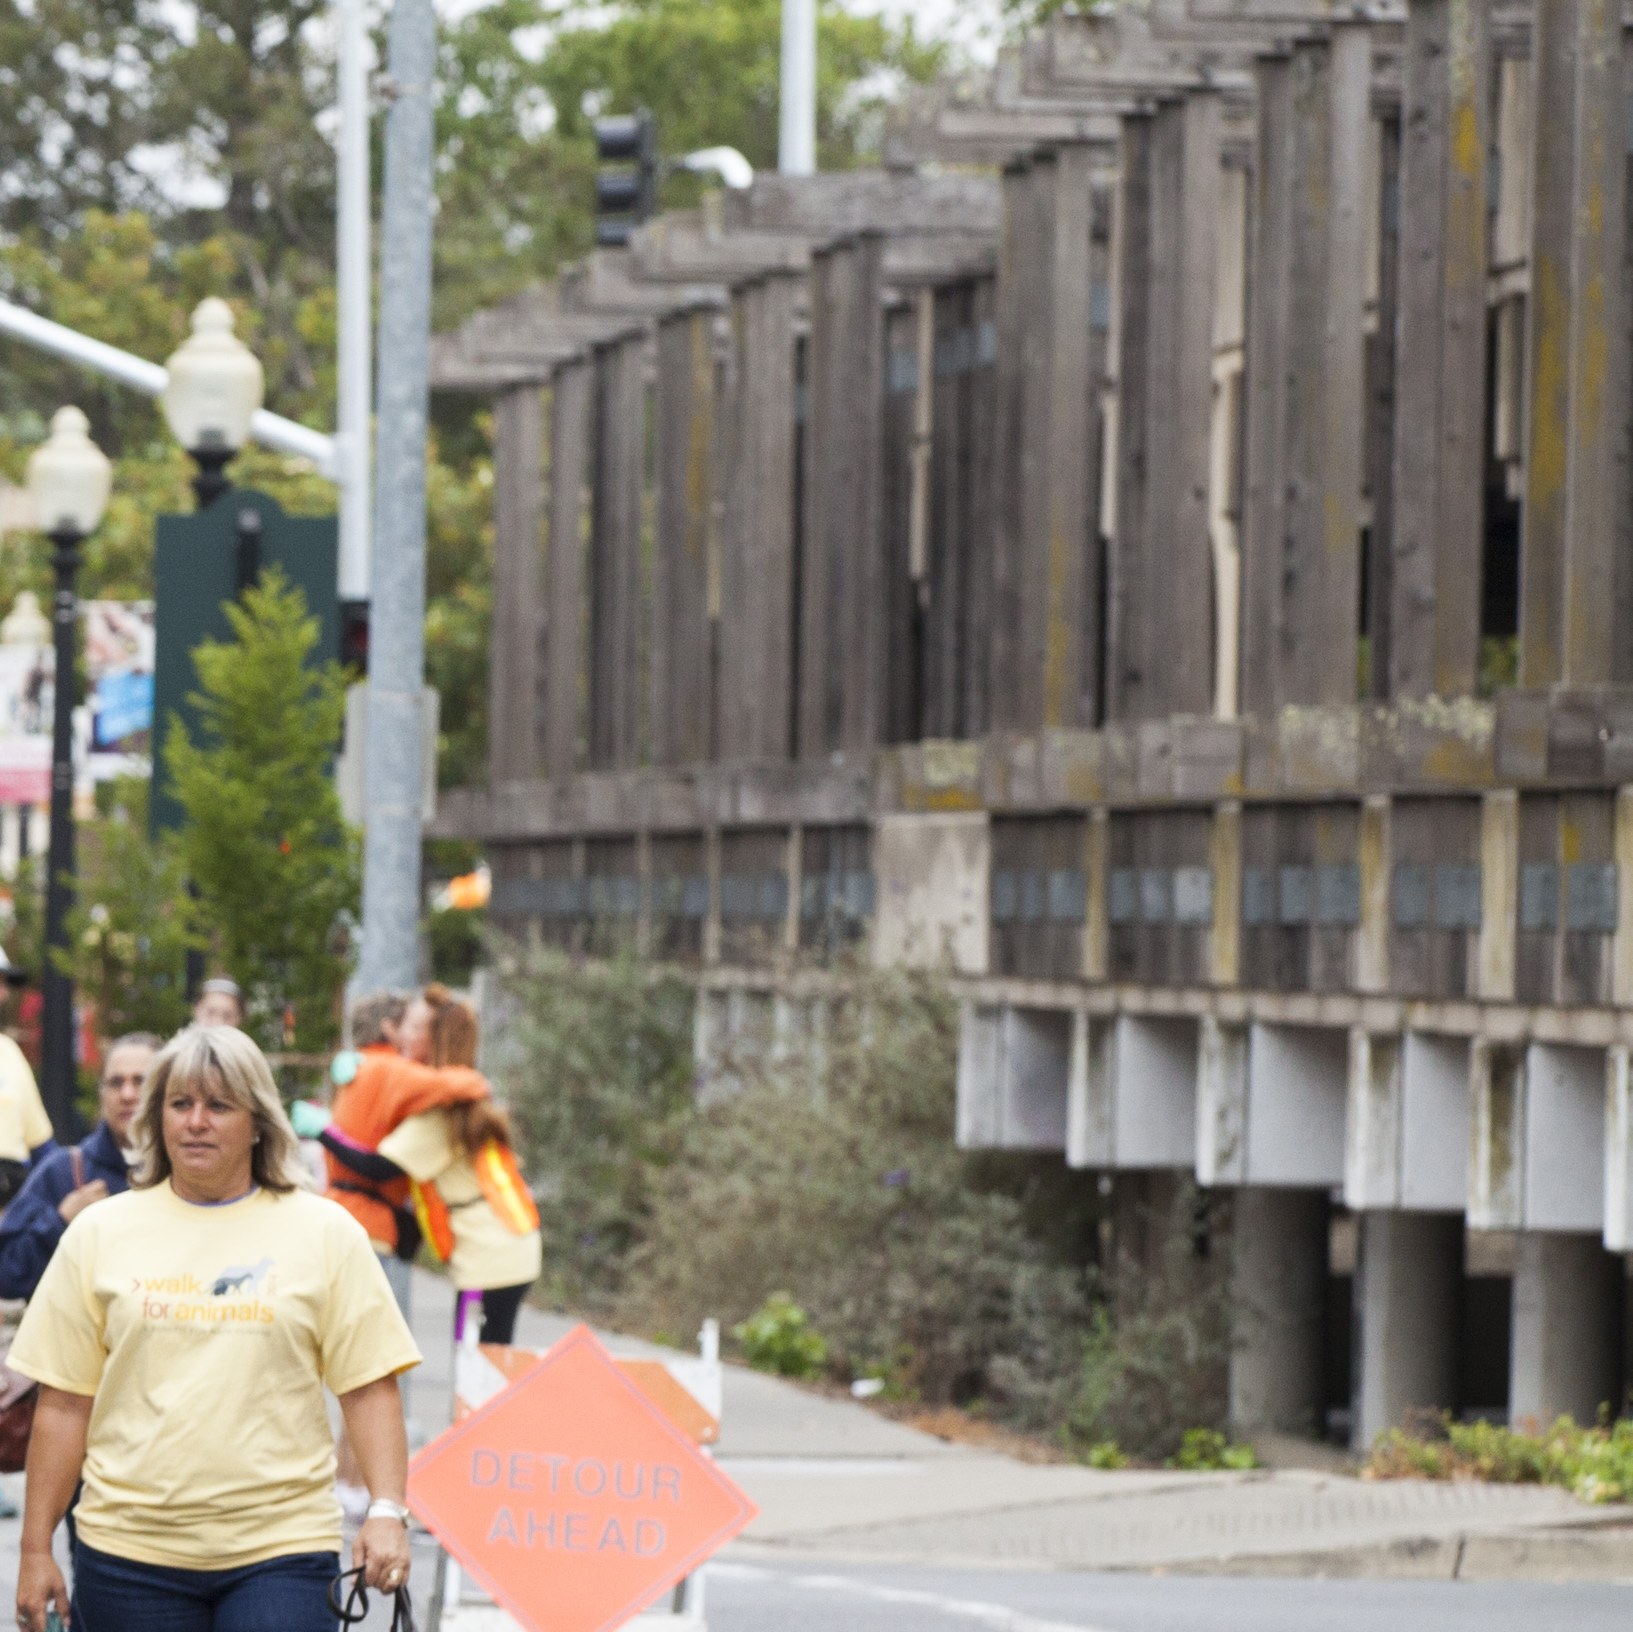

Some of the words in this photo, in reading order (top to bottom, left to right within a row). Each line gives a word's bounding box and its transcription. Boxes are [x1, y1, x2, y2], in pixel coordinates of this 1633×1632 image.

[145, 1273, 203, 1296] walk
[143, 1296, 171, 1320] for
[175, 1299, 276, 1325] animals
[470, 1449, 682, 1503] DETOUR
[488, 1506, 667, 1558] AHEAD
